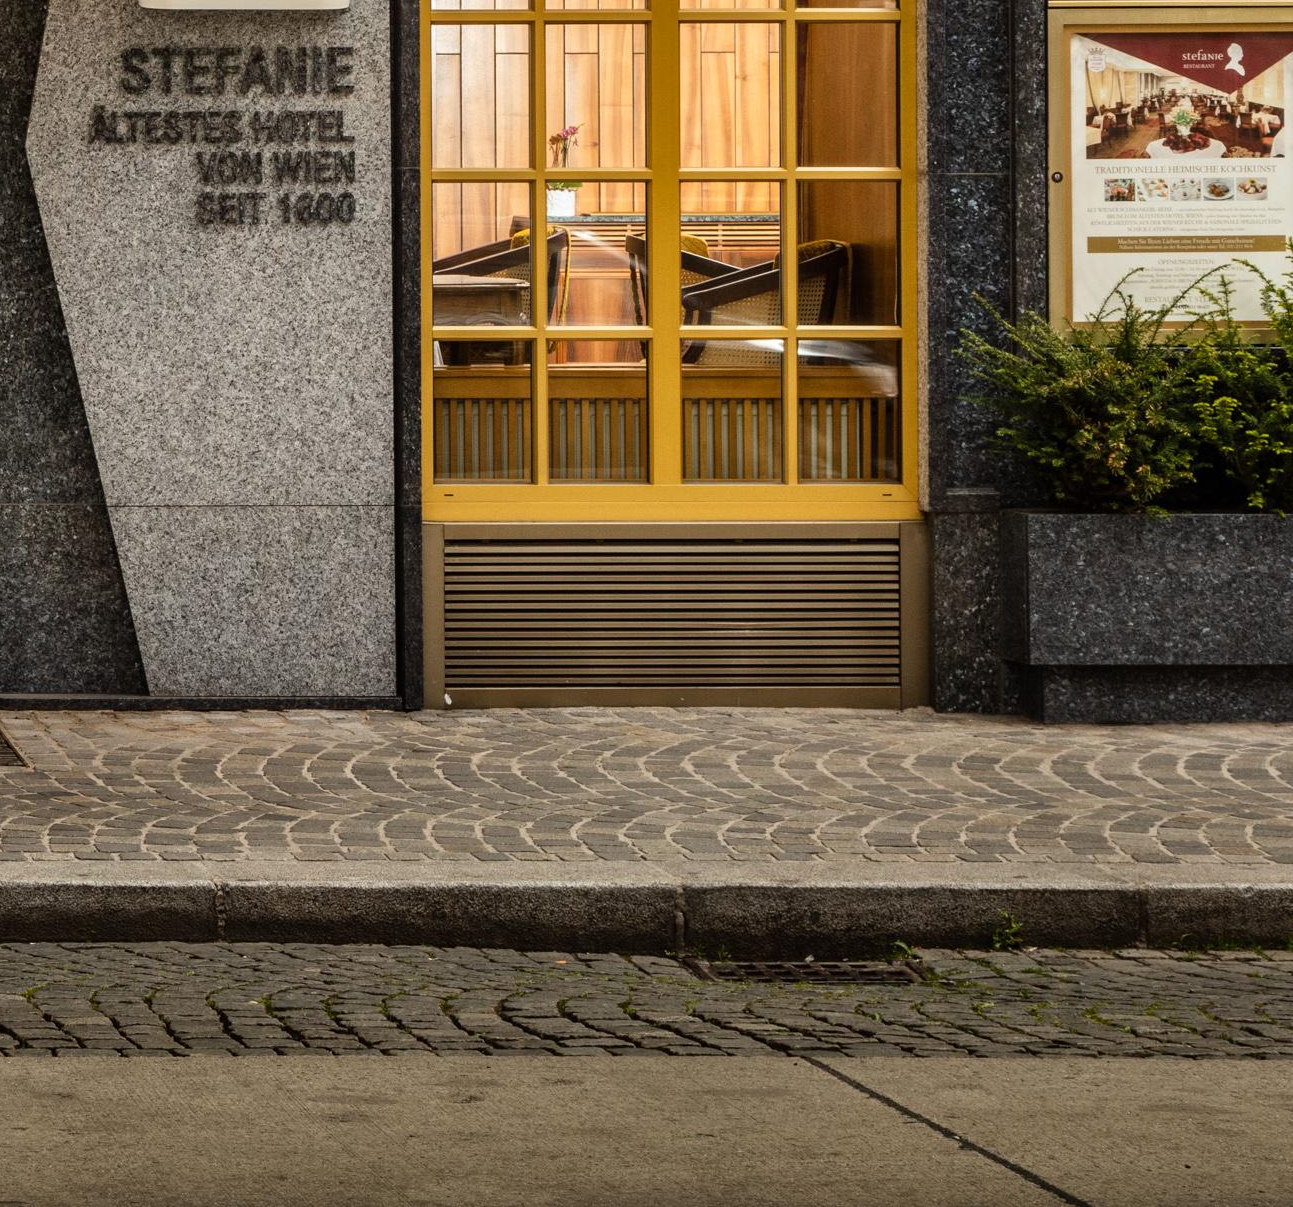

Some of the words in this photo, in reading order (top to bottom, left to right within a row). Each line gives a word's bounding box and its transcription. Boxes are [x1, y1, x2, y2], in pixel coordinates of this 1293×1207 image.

[119, 46, 355, 96] STEFANIE
[88, 104, 243, 145] ÄLTESTES
[249, 110, 355, 144] HOTEL
[194, 150, 264, 185] VON
[271, 150, 356, 184] WIEN
[1094, 165, 1169, 174] TRADITIONELLE
[1169, 165, 1218, 174] HEIMISCHE
[1219, 165, 1277, 173] KOCHKUNST
[195, 191, 267, 226] SEIT
[277, 191, 357, 226] 1600
